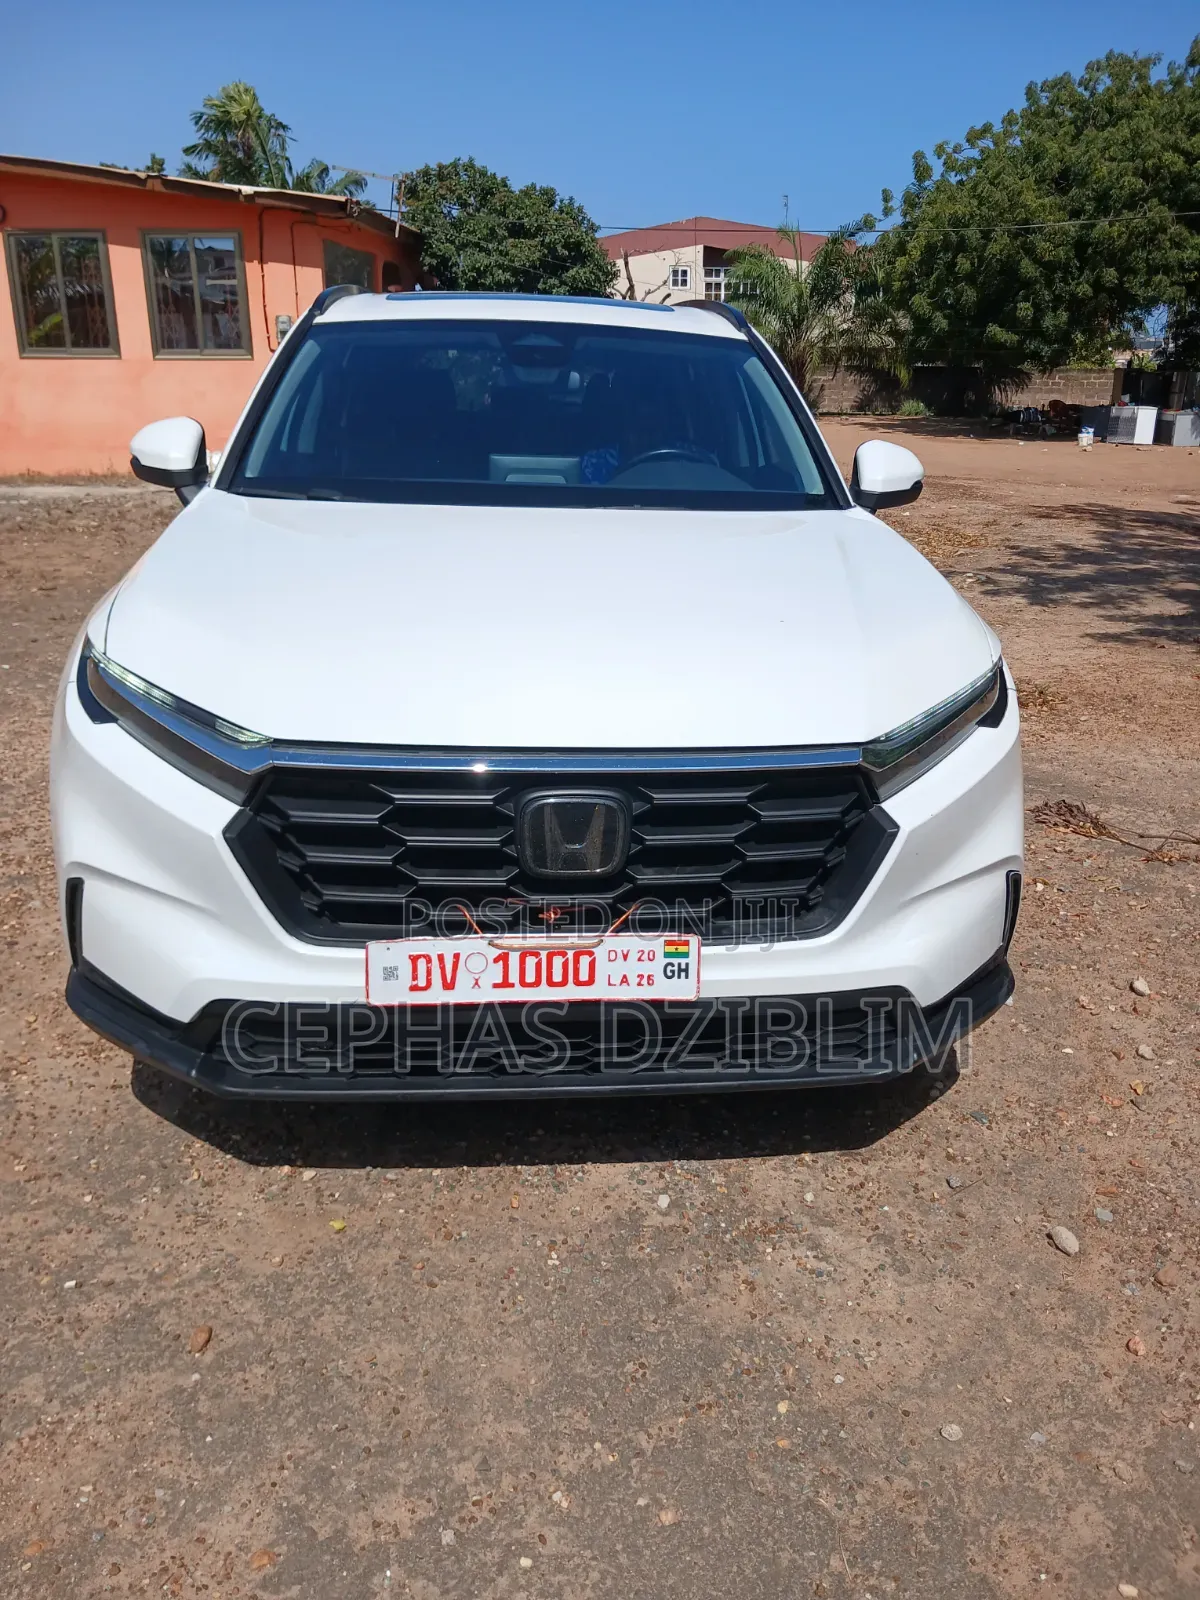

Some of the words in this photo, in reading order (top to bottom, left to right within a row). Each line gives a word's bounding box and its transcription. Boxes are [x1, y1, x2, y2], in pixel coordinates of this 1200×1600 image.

[608, 949, 630, 962] DV
[637, 949, 656, 962] 20
[408, 952, 461, 992] DV
[492, 949, 596, 989] 1000
[663, 962, 689, 979] GH
[608, 974, 630, 987] LA
